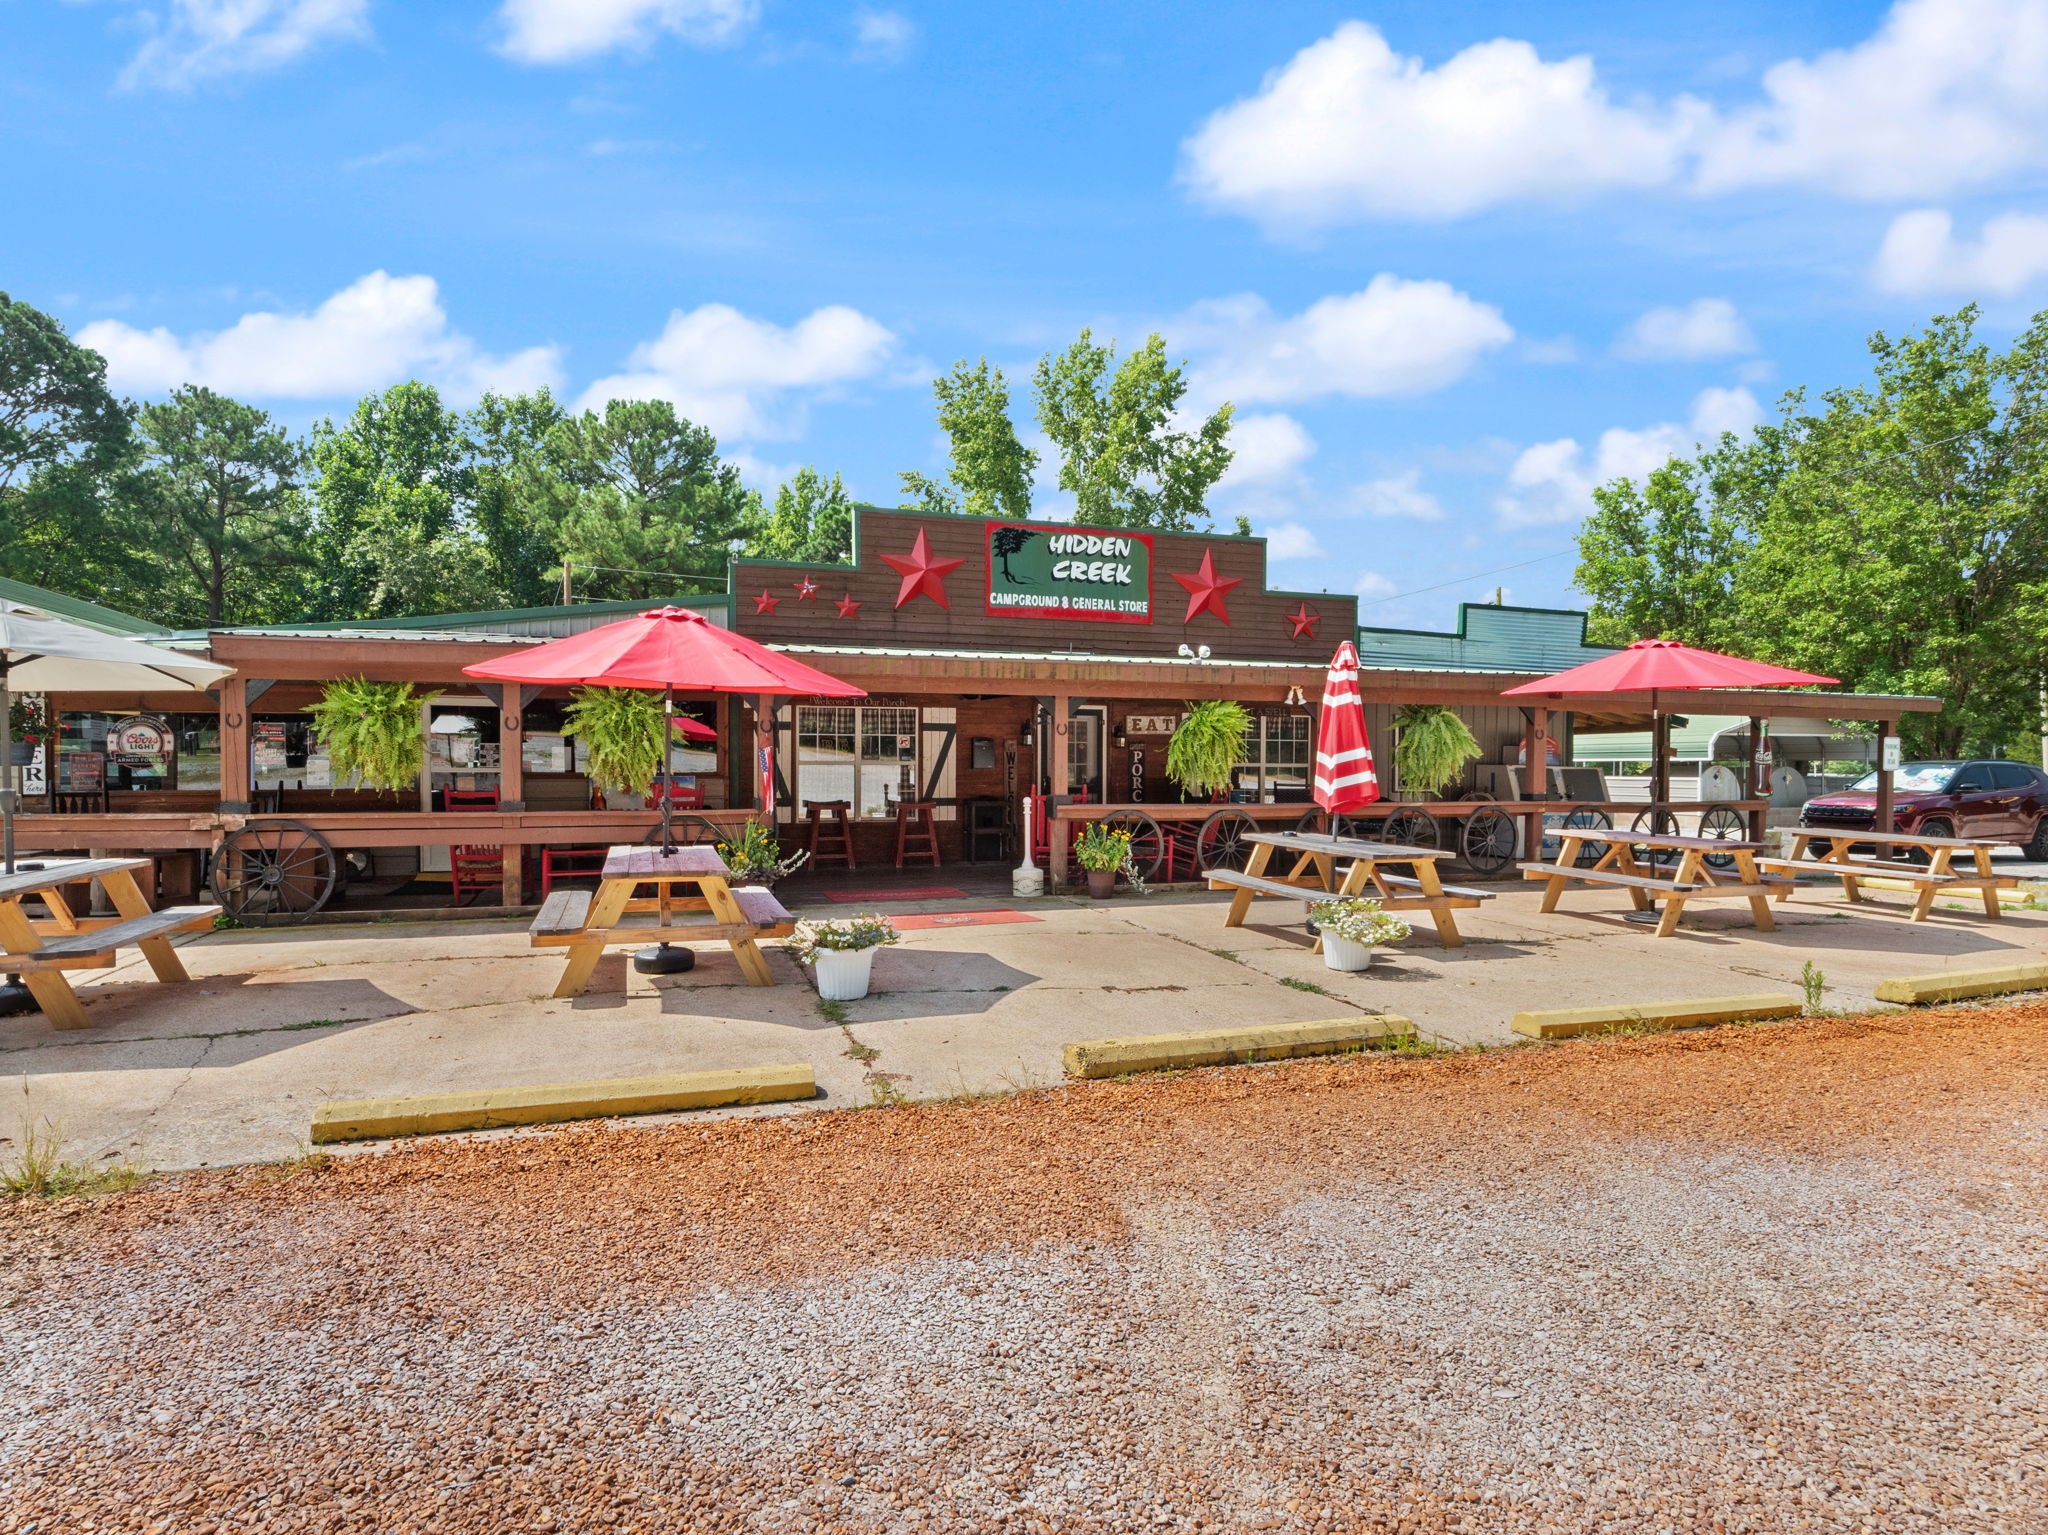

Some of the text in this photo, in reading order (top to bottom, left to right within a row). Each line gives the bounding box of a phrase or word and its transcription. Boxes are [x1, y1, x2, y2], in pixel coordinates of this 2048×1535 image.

[1048, 534, 1132, 557] HIDDEN
[1052, 560, 1132, 585] CREEK
[989, 592, 1060, 607] CAMPGROUND
[1072, 597, 1116, 612] GENERAL
[1118, 600, 1148, 613] STORE
[1131, 718, 1172, 731] EAT
[127, 733, 159, 744] Coors
[1131, 750, 1143, 802] PORC
[24, 783, 44, 792] here
